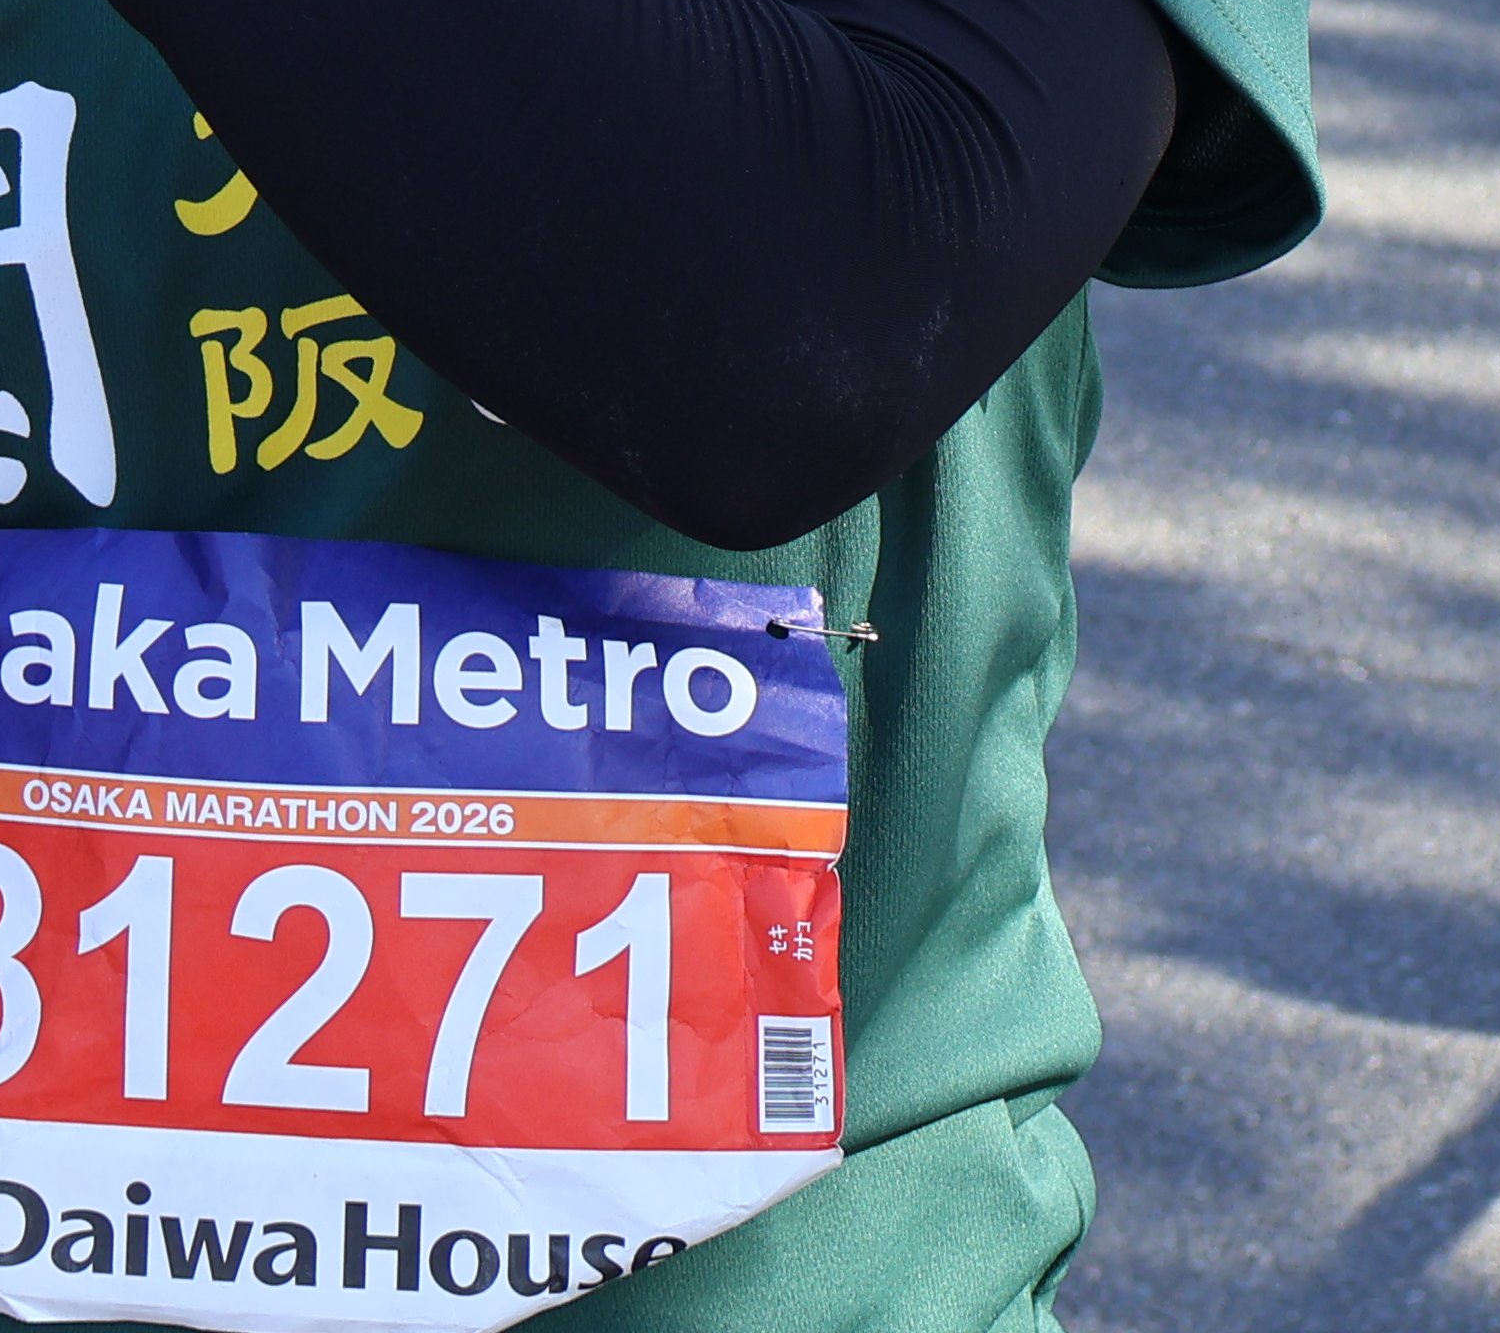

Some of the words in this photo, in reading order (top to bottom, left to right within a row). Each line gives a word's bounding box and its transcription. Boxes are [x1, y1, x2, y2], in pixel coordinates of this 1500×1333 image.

[300, 600, 758, 738] Metro
[22, 778, 153, 821] OSAKA
[165, 790, 399, 833] MARATHON
[410, 800, 515, 835] 2026
[767, 923, 789, 955] セキ
[791, 920, 814, 962] カナコ
[812, 1040, 830, 1107] 31271
